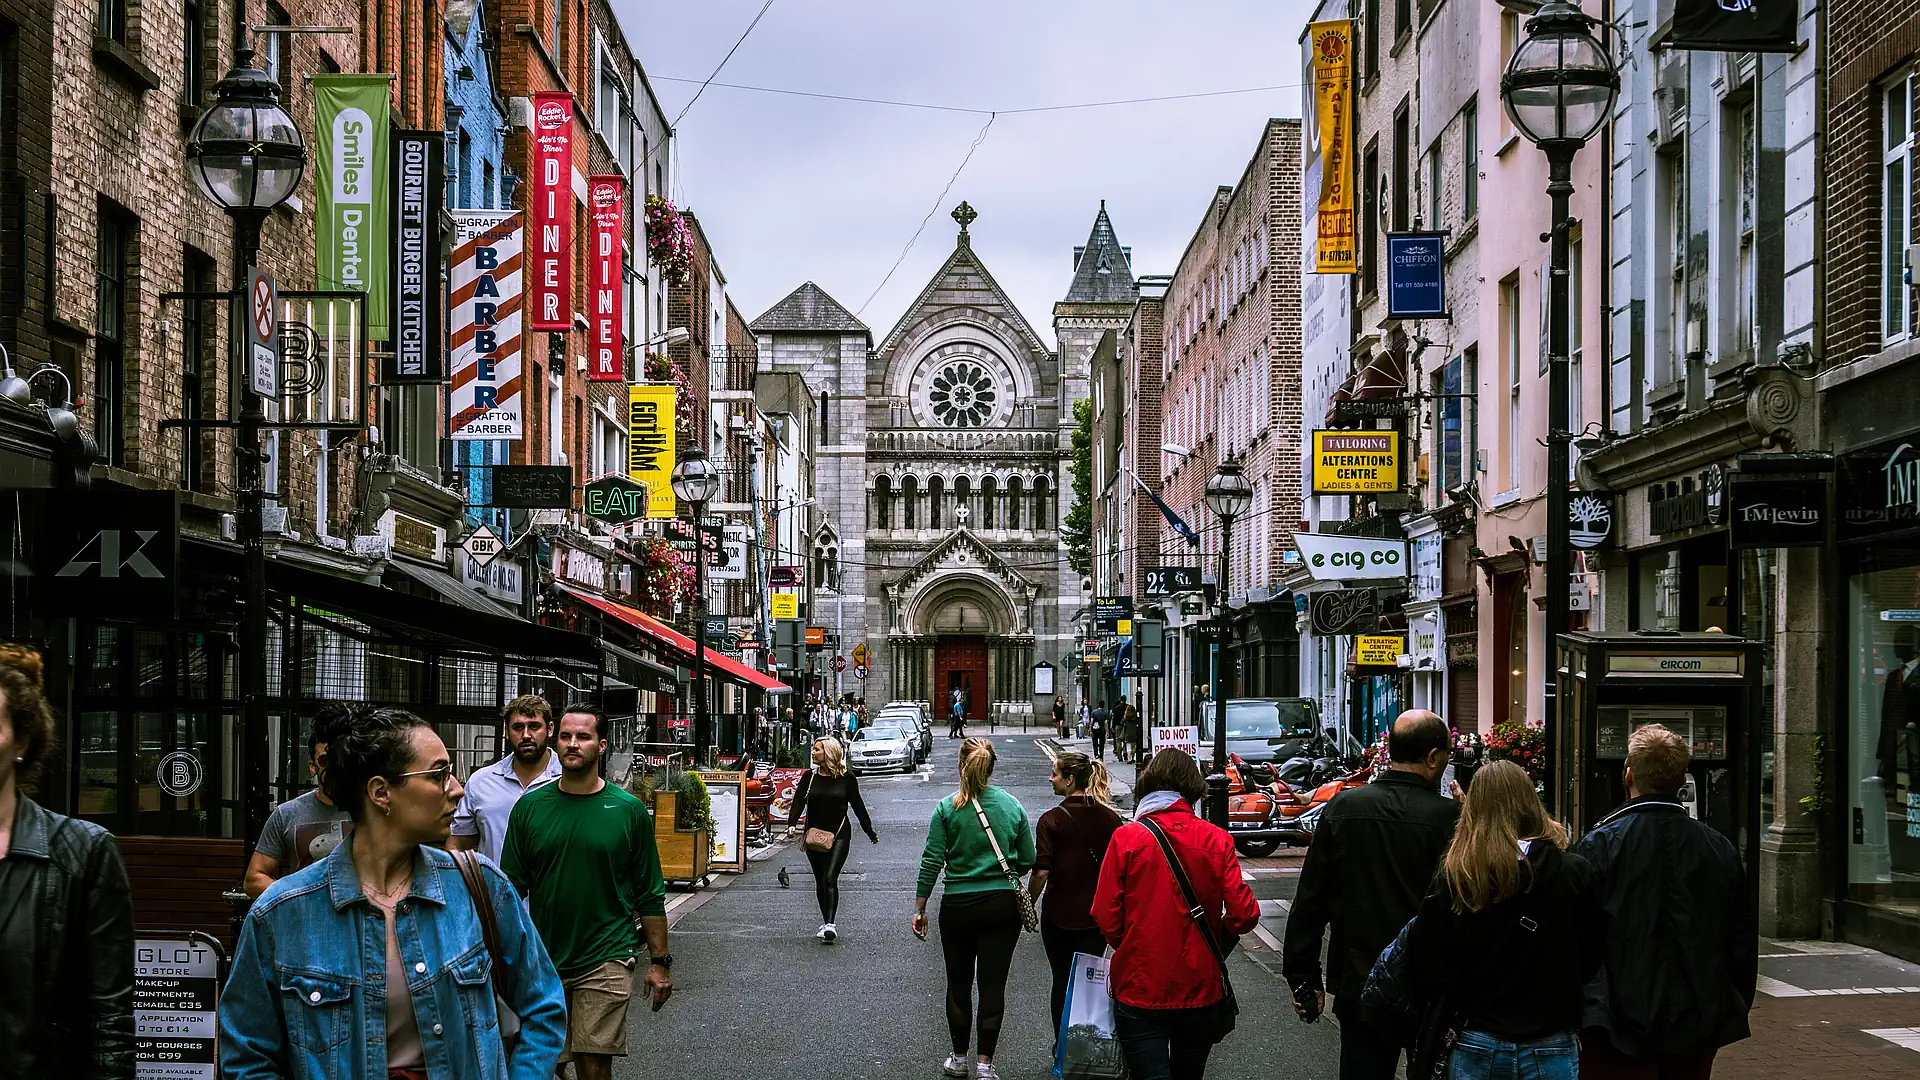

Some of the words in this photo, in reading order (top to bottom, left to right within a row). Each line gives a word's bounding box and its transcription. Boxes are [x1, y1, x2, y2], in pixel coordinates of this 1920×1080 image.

[343, 120, 364, 196] Smiles
[403, 140, 422, 224] GOURMET
[458, 218, 466, 239] THE
[466, 218, 518, 228] GRAFTON
[1320, 212, 1352, 236] CENTRE
[468, 230, 513, 240] BARBER
[543, 158, 560, 321] DINER
[342, 209, 363, 291] Dental
[403, 228, 422, 295] BURGER
[1394, 255, 1436, 264] CHIFFON
[598, 232, 614, 373] DINER
[472, 246, 500, 410] BARBER
[403, 300, 420, 375] KITCHEN
[466, 412, 517, 421] GRAFTON
[467, 424, 512, 434] BARBER
[631, 402, 669, 471] GOTHAM
[1328, 438, 1387, 450] TAILORING
[1322, 456, 1394, 466] ALTERATIONS
[1336, 468, 1378, 480] CENTRE
[589, 486, 642, 516] EAT
[700, 517, 722, 528] INES
[472, 540, 494, 552] GBK
[1312, 554, 1324, 567] e
[1330, 551, 1365, 570] cig
[1370, 550, 1400, 565] co
[508, 568, 516, 594] SIX
[829, 660, 846, 668] SOP
[1160, 730, 1170, 740] DO
[1173, 729, 1189, 740] NOT
[1178, 744, 1196, 754] THIS
[138, 948, 208, 964] GLOT
[152, 968, 190, 976] STORE
